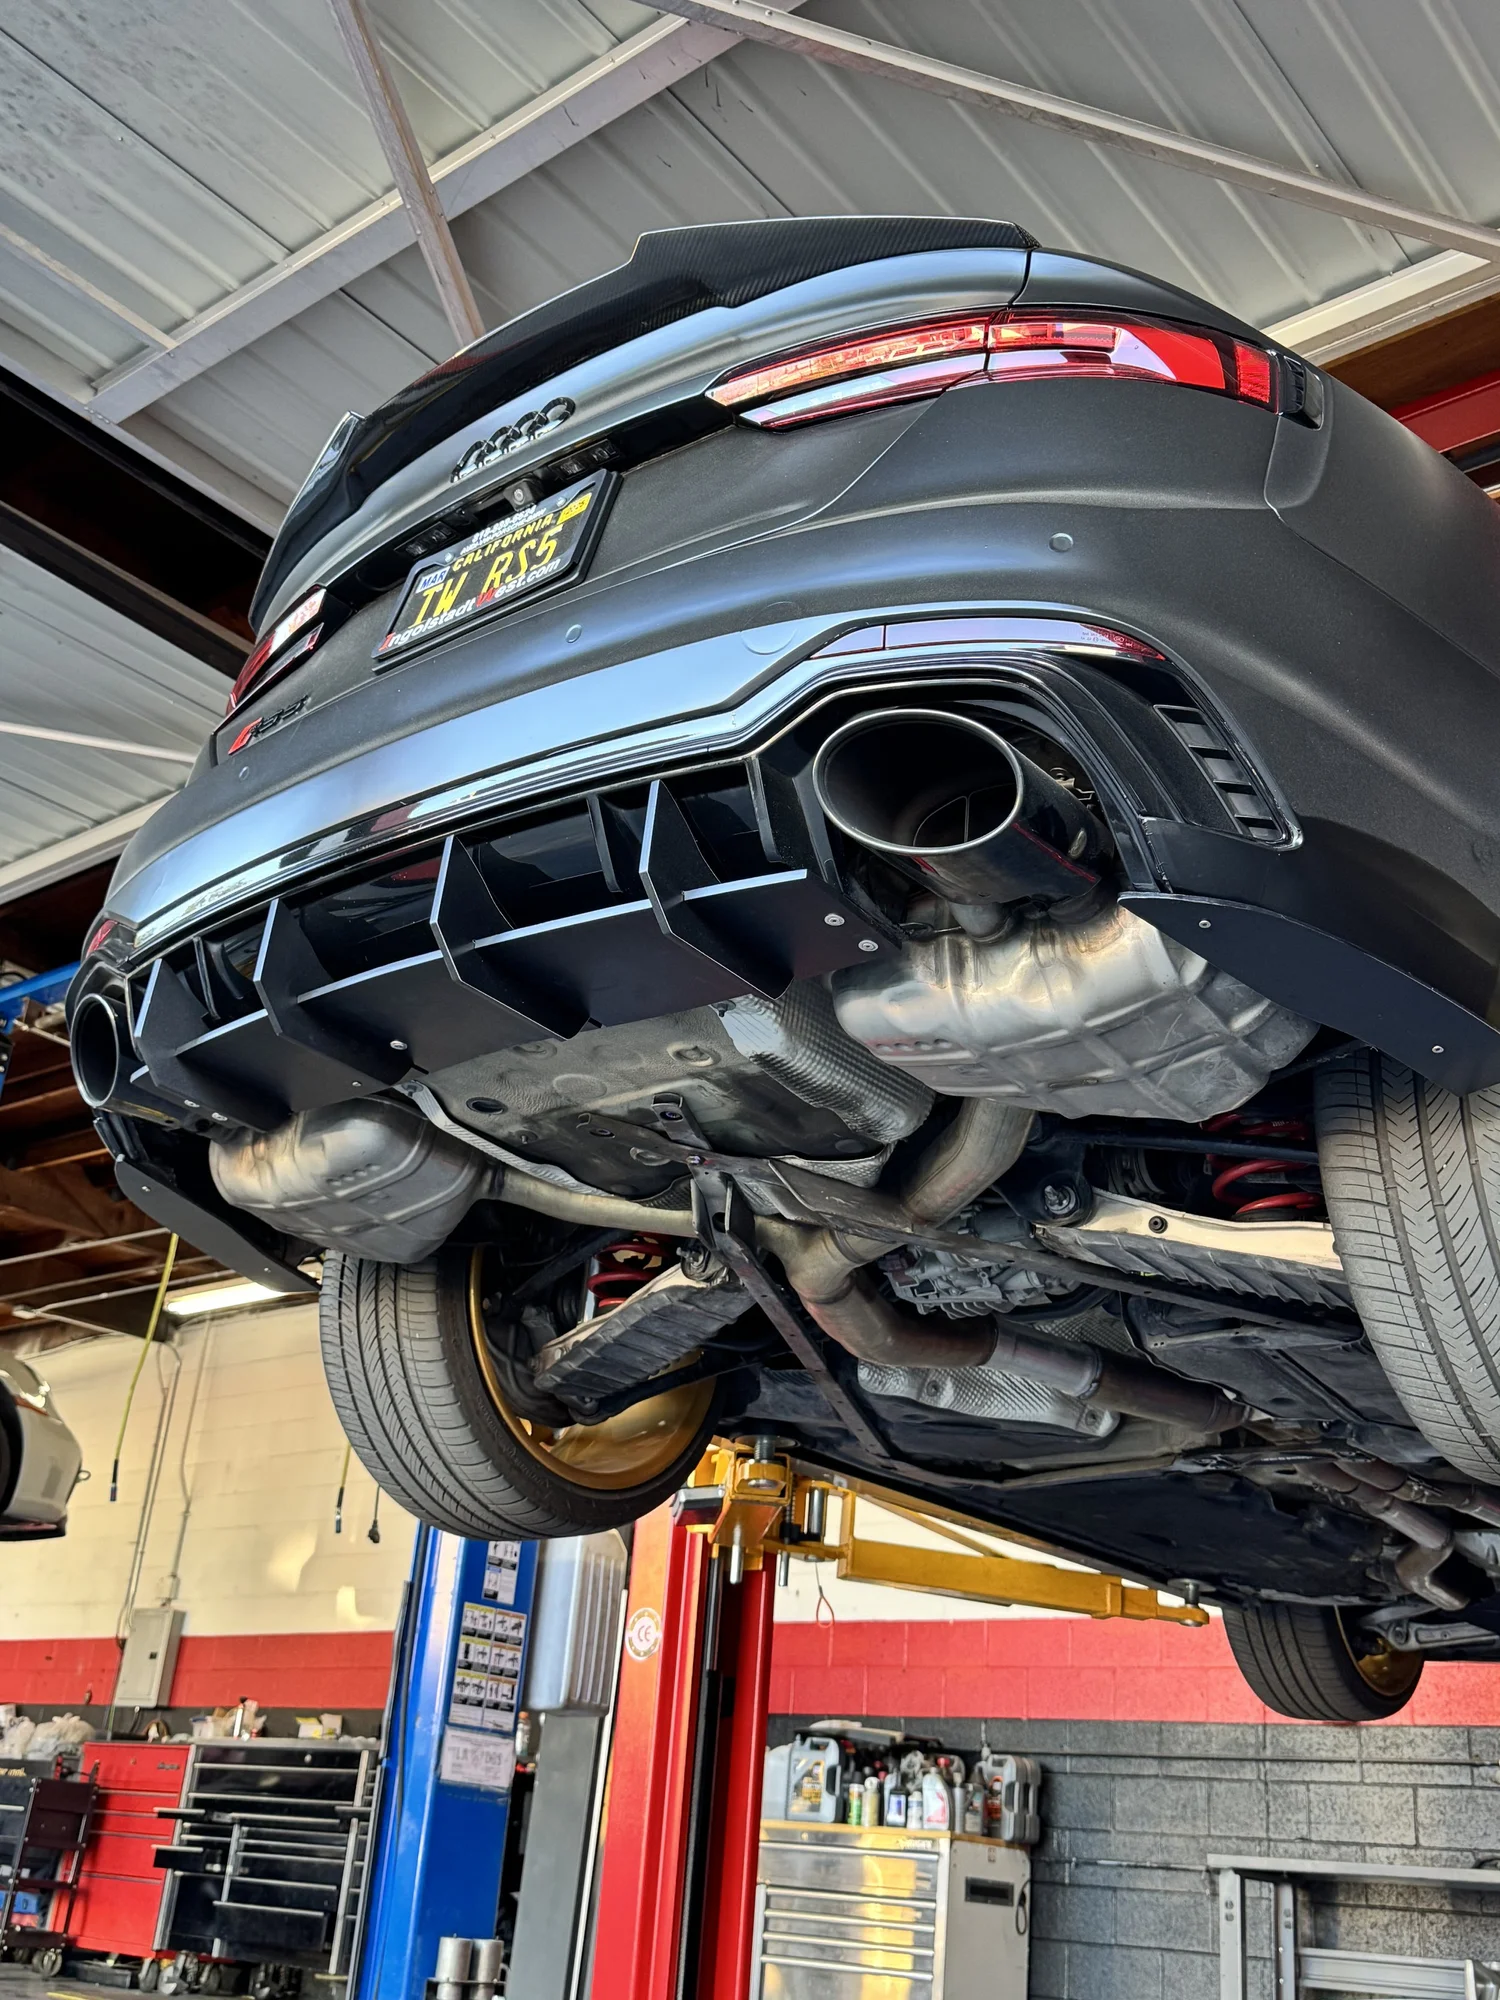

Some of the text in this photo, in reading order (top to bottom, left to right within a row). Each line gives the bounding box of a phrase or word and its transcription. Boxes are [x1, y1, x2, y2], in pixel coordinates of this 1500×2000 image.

[452, 513, 554, 572] CALIFORNIA
[481, 524, 564, 594] RS5
[378, 558, 561, 651] IngolstadtWest.com
[422, 570, 447, 589] MAR
